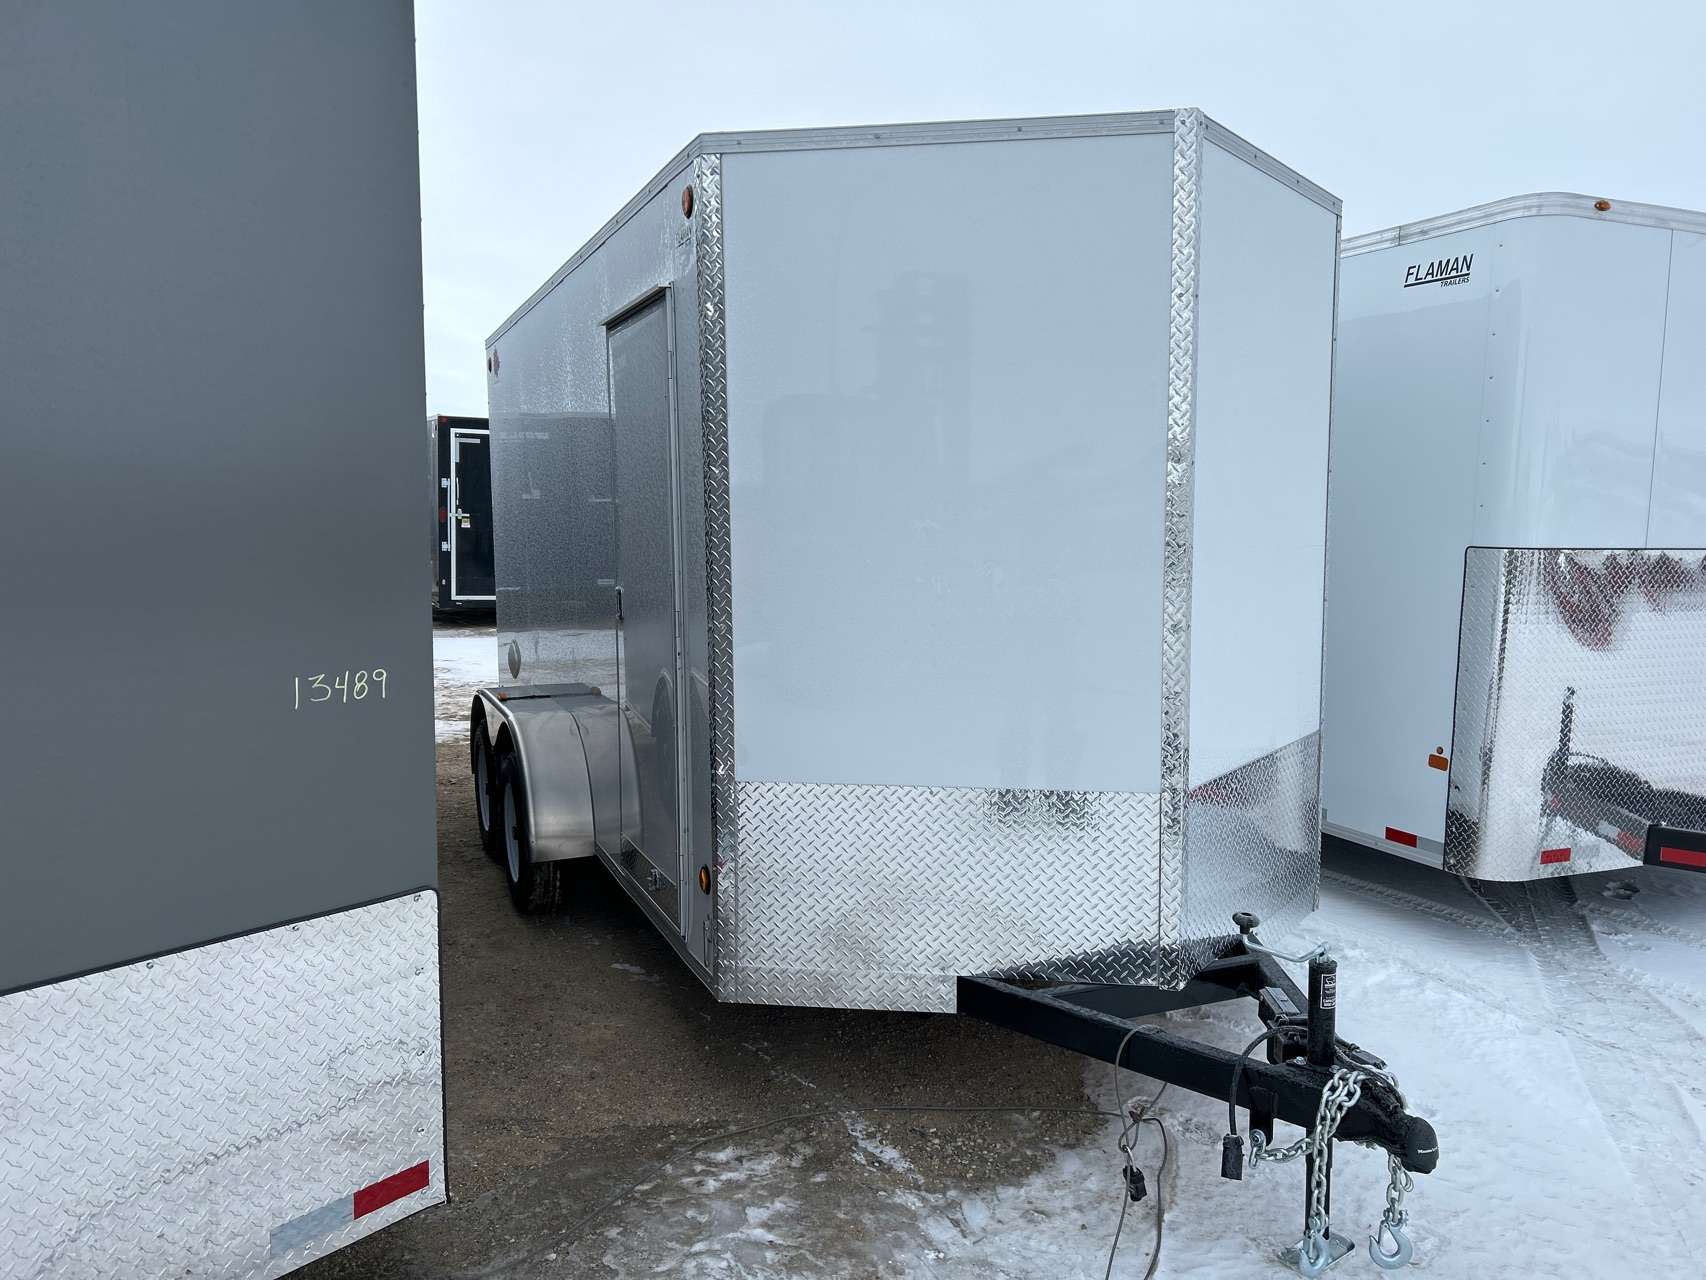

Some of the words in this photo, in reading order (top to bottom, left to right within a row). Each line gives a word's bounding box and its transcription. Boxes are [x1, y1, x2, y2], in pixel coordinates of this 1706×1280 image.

[1404, 253, 1474, 284] FLAMAN
[1440, 276, 1470, 288] TRAILERS
[295, 668, 387, 710] 13489
